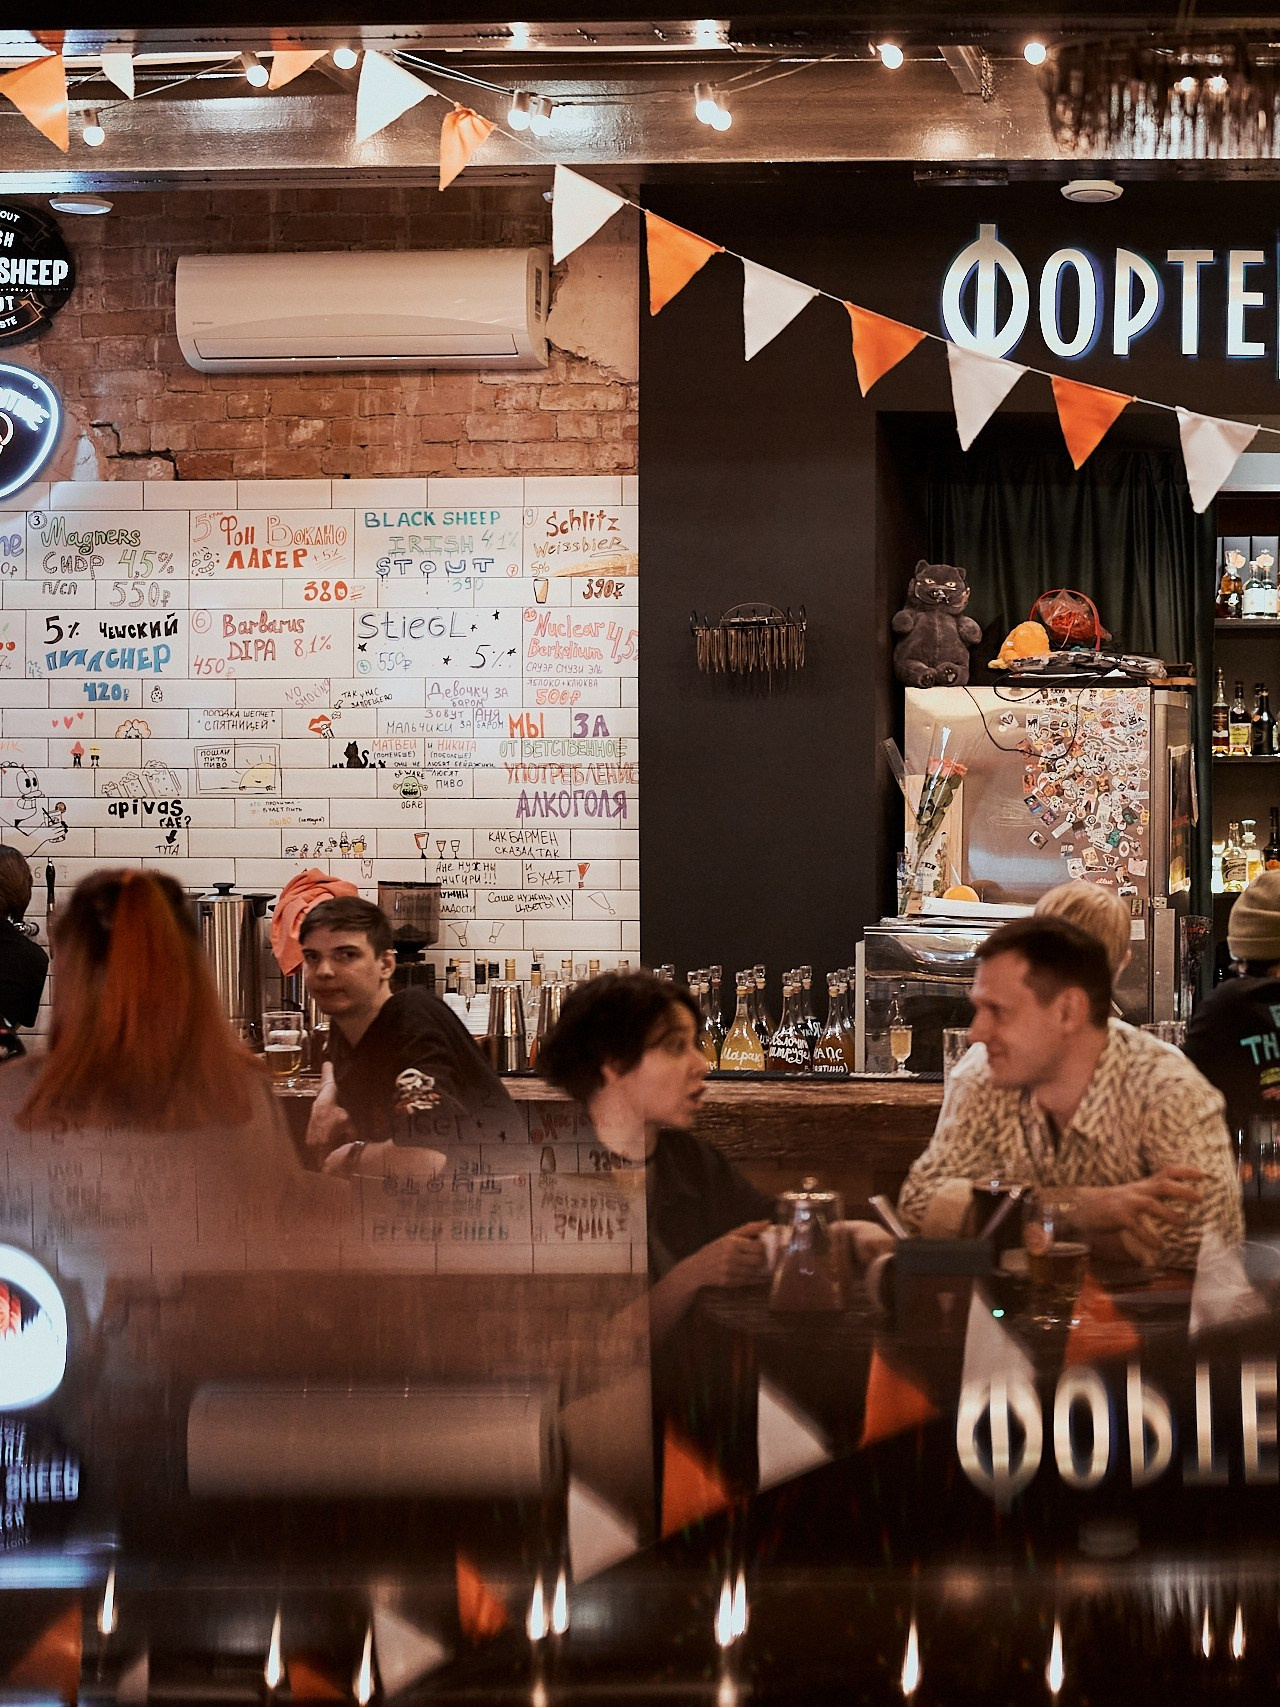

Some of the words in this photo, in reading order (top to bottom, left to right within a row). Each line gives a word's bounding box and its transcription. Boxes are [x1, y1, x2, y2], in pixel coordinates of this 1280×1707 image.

[0, 257, 69, 286] SHEEP
[364, 512, 436, 528] BLACK
[443, 511, 501, 526] SHEEP
[546, 509, 620, 537] Schlitz
[388, 535, 474, 556] IRISH
[226, 547, 308, 570] ЛАГЕР
[376, 557, 494, 576] STOUT
[100, 612, 178, 640] ЧЕШСКИЙ
[534, 611, 605, 638] Nuclear
[45, 643, 171, 673] ПИЛСНЕР
[227, 639, 276, 661] DIPA
[386, 720, 453, 734] МАЛЬЧИКИ
[508, 712, 545, 738] МЫ
[573, 713, 610, 738] ЗА
[437, 740, 477, 752] НИКИТА
[435, 779, 464, 789] ПИВО
[108, 799, 184, 818] apivas
[515, 789, 628, 819] АЛКОГОЛЯ
[509, 831, 559, 846] БАРМЕН
